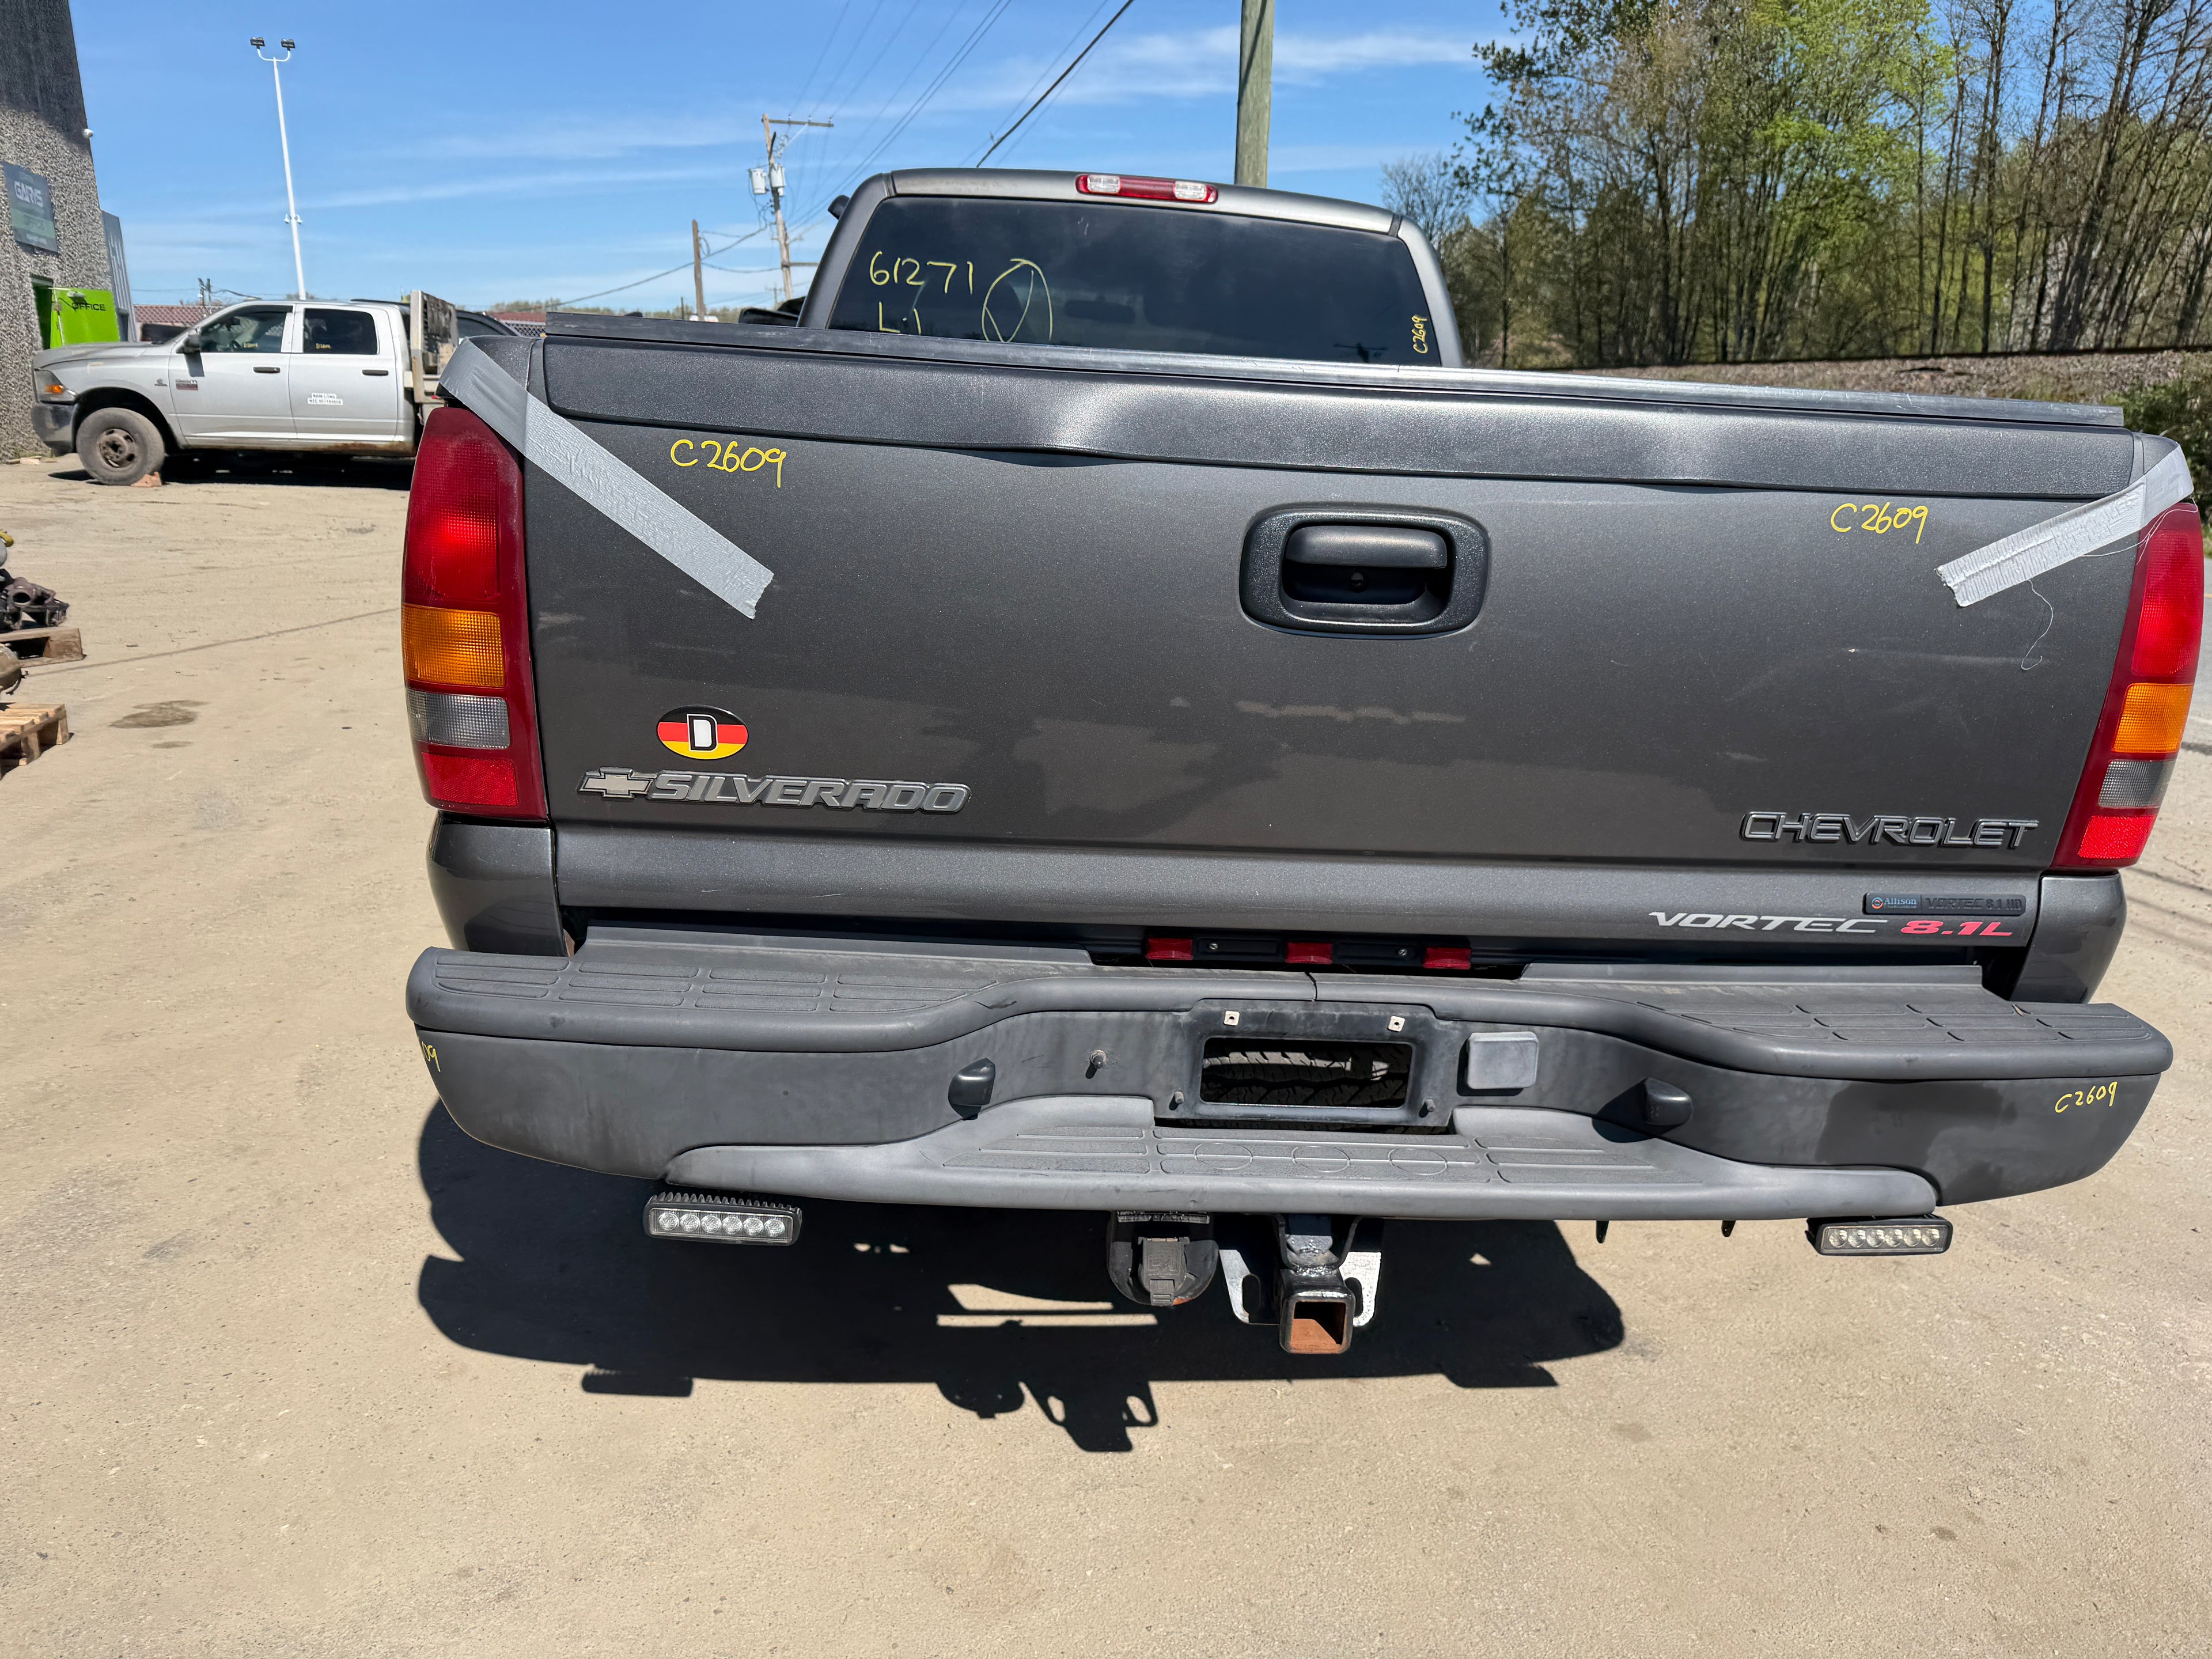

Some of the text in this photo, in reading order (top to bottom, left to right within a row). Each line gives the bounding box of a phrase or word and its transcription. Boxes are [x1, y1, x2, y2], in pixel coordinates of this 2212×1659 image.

[72, 303, 105, 311] OFFICE
[1411, 315, 1429, 354] C2609
[671, 439, 787, 488] C2609
[1831, 502, 1929, 544] C2609
[687, 714, 718, 752] D
[646, 770, 971, 814] SILVERADO
[1738, 811, 2039, 848] CHEVROLET
[1925, 897, 1984, 910] VORTEC
[1649, 911, 2013, 937] VORTEC 8.1L
[2055, 1081, 2118, 1113] C2609
